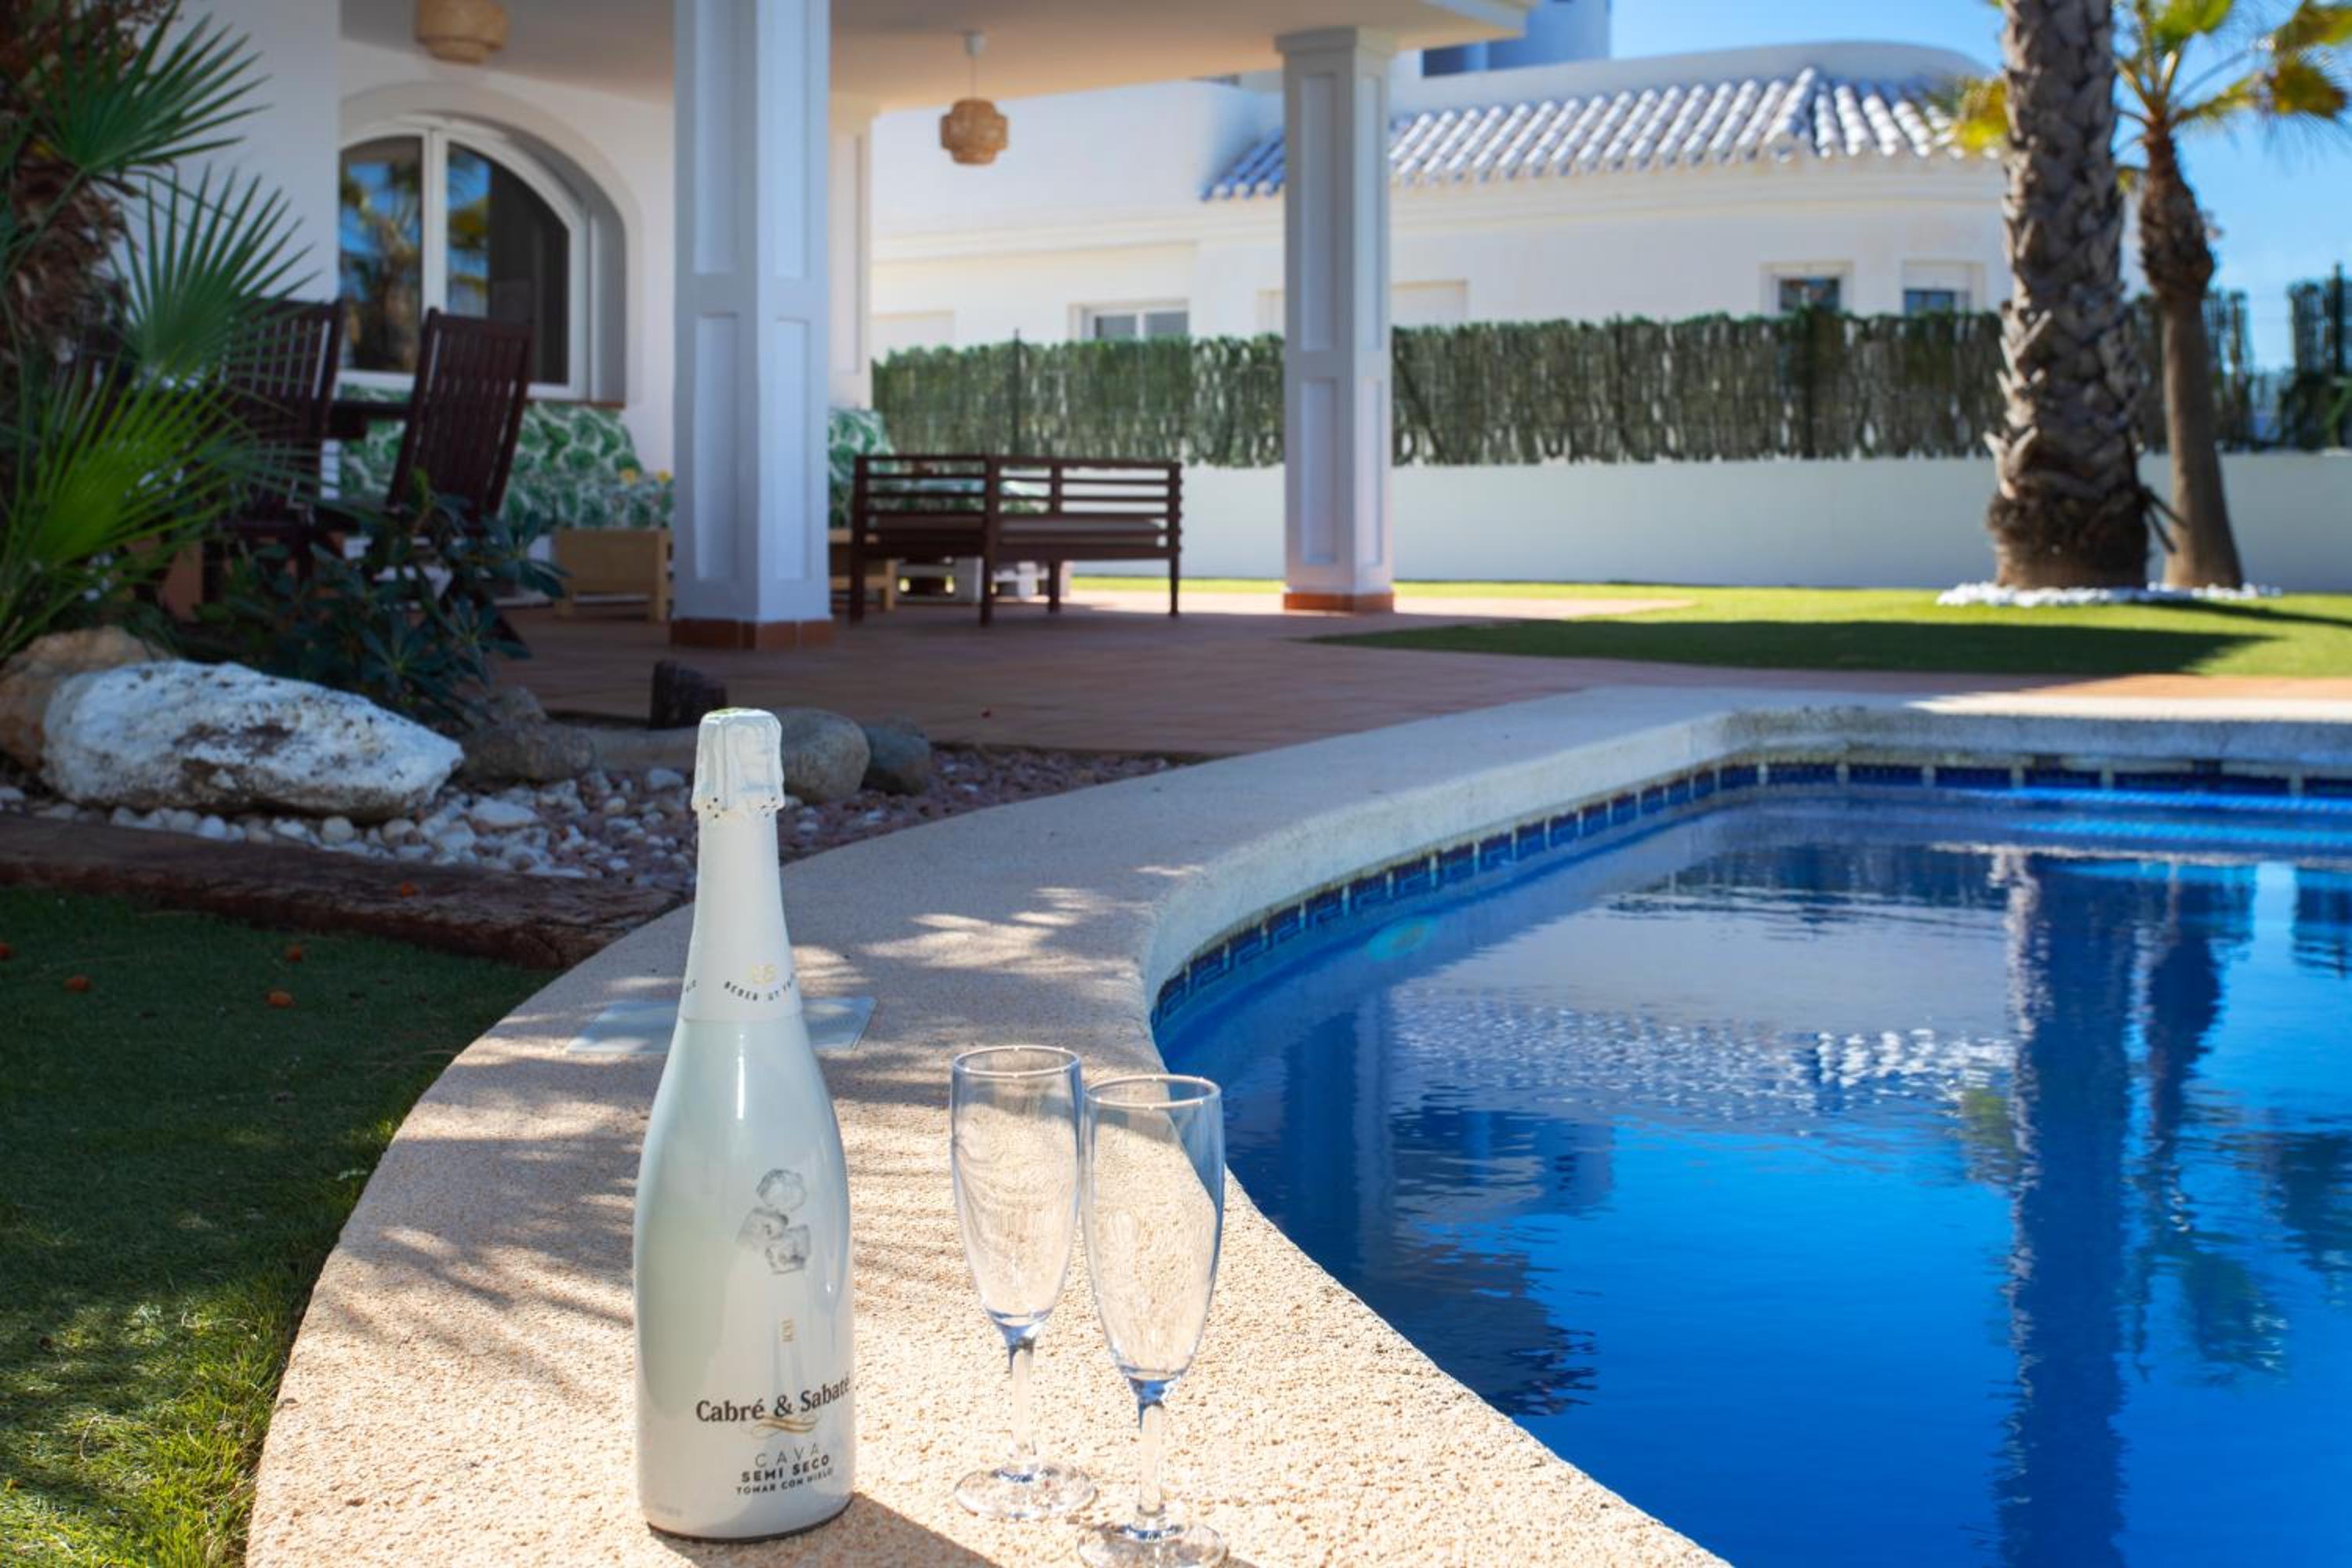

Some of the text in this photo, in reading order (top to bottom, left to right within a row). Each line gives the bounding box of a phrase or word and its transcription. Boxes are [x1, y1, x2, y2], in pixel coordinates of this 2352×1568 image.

[696, 1399, 765, 1421] Cabré
[774, 1395, 793, 1417] &
[741, 1454, 829, 1483] SEMI SECO
[755, 1443, 818, 1468] CAVA
